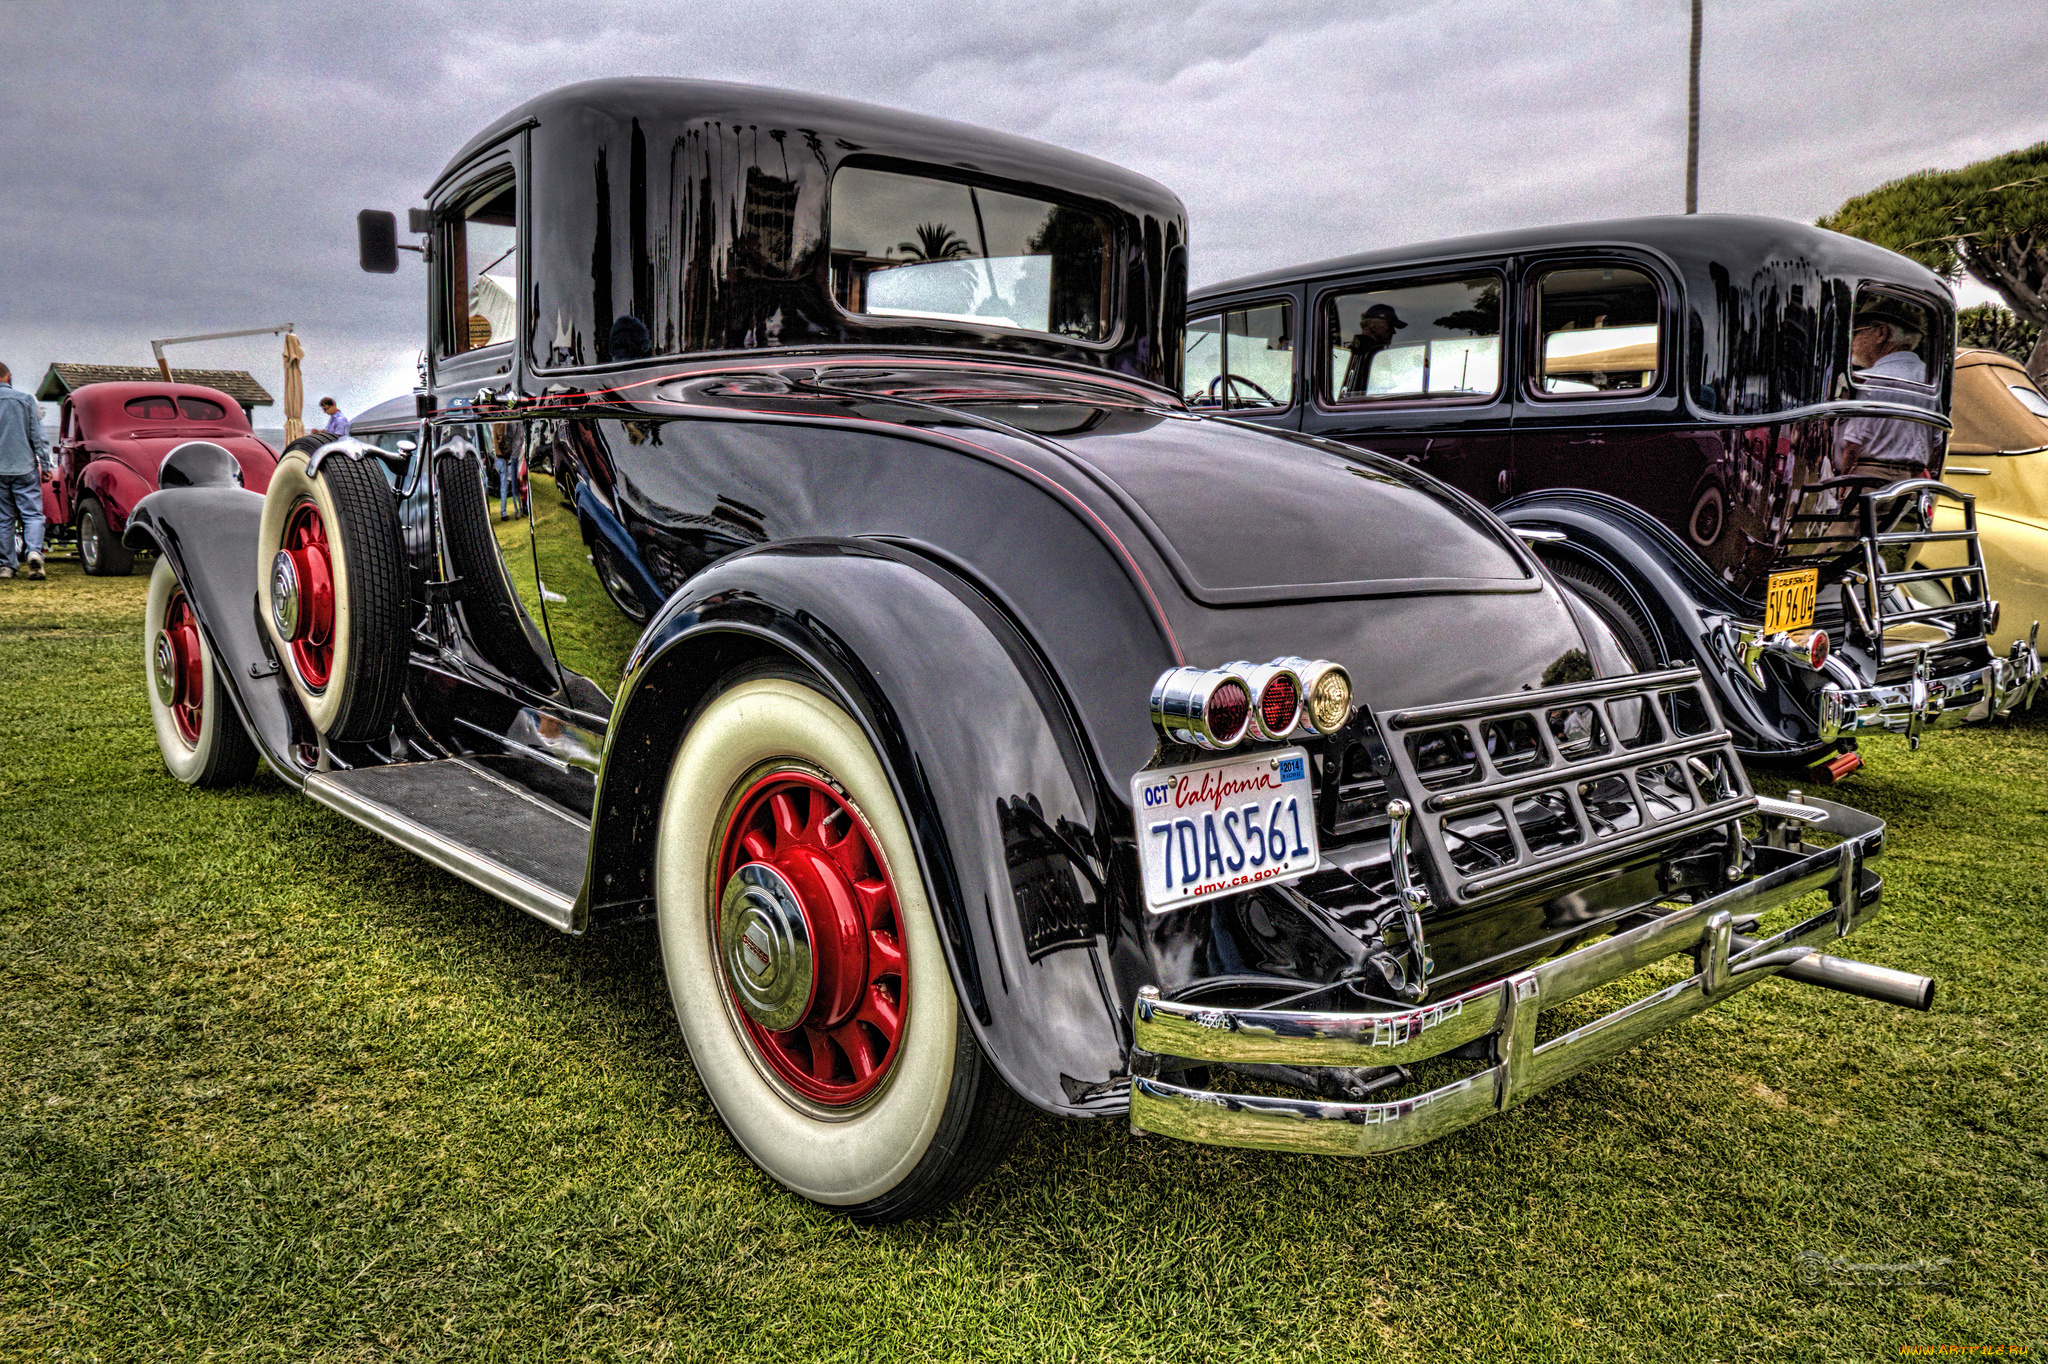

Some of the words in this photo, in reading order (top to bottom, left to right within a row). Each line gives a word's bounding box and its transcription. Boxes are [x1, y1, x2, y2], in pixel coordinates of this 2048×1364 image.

[1283, 761, 1300, 774] 2014
[1145, 784, 1168, 807] OCT
[1175, 767, 1282, 811] California
[1151, 797, 1309, 888] 7DAS561
[1193, 867, 1281, 896] dmv.ca.gov
